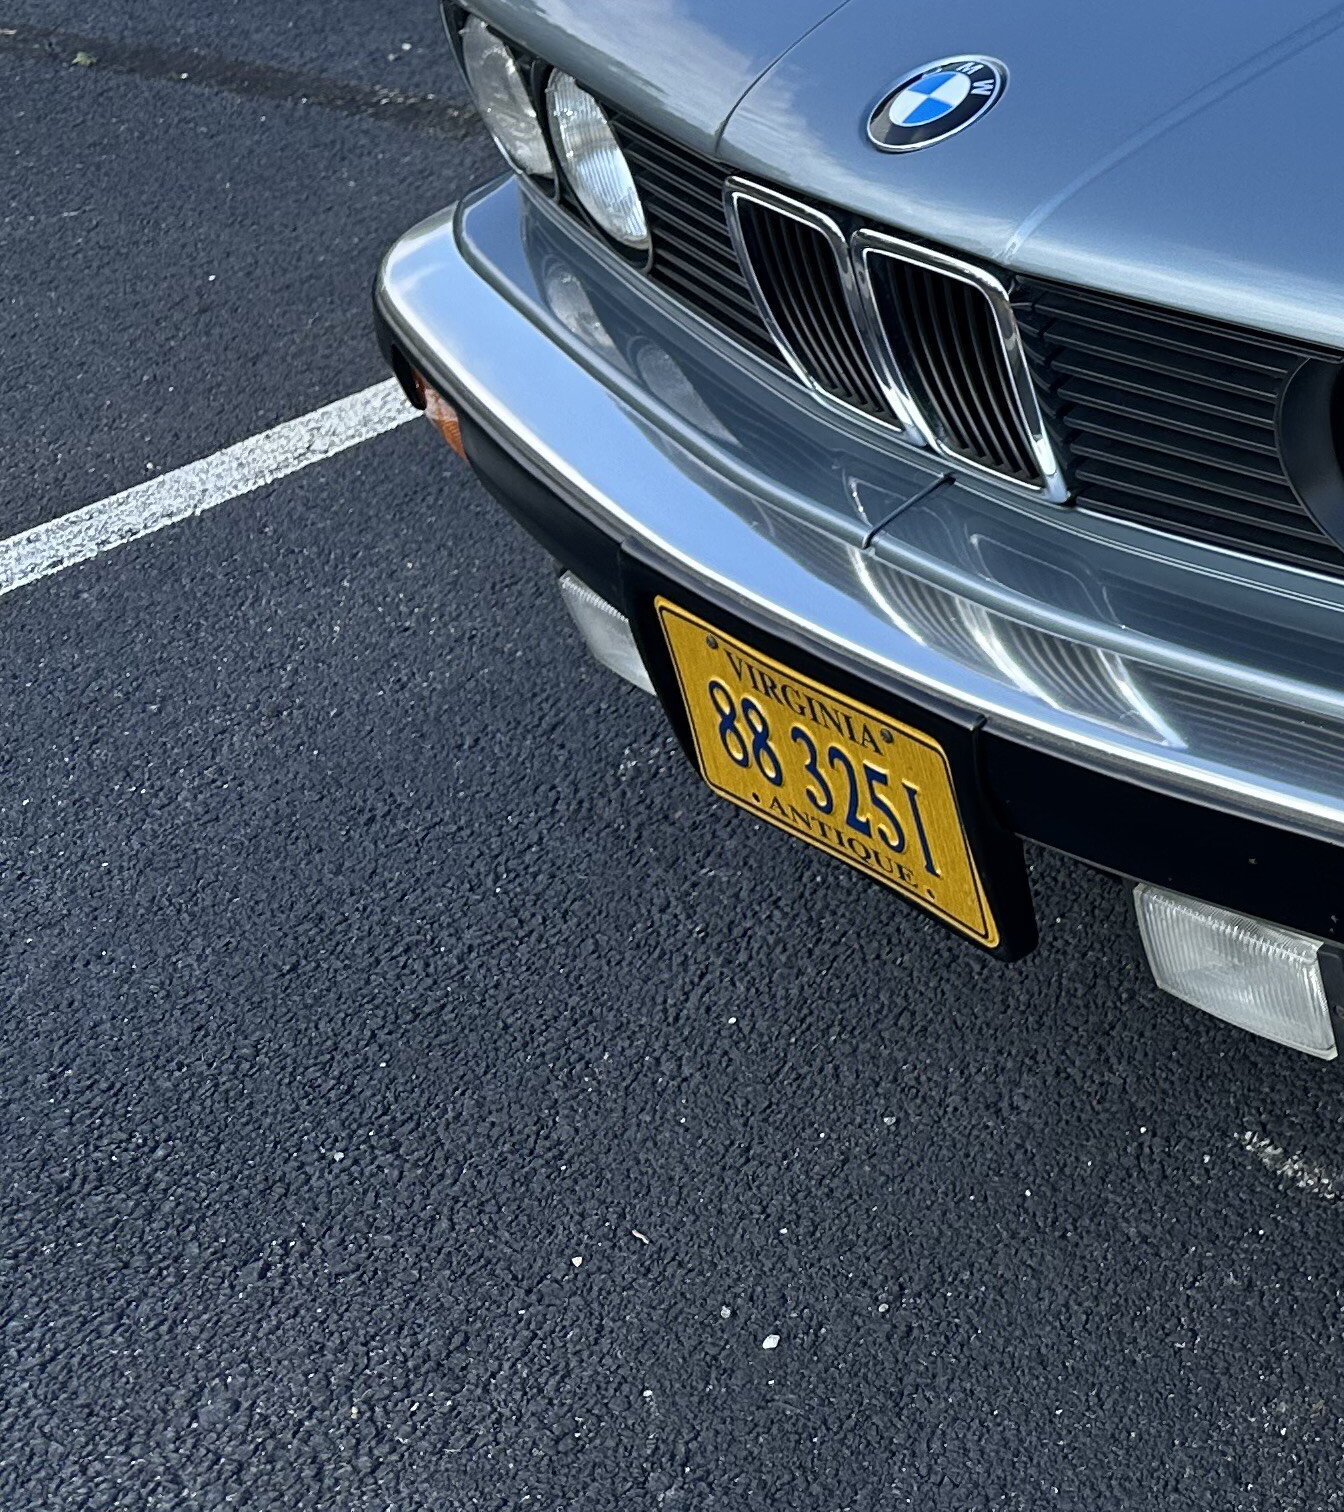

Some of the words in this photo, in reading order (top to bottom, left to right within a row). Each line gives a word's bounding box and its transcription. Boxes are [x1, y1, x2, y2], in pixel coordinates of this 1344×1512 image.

[725, 649, 883, 756] VIRGINIA
[708, 679, 783, 787] 88
[791, 725, 942, 879] 3251
[770, 796, 919, 888] ANTIQUE
